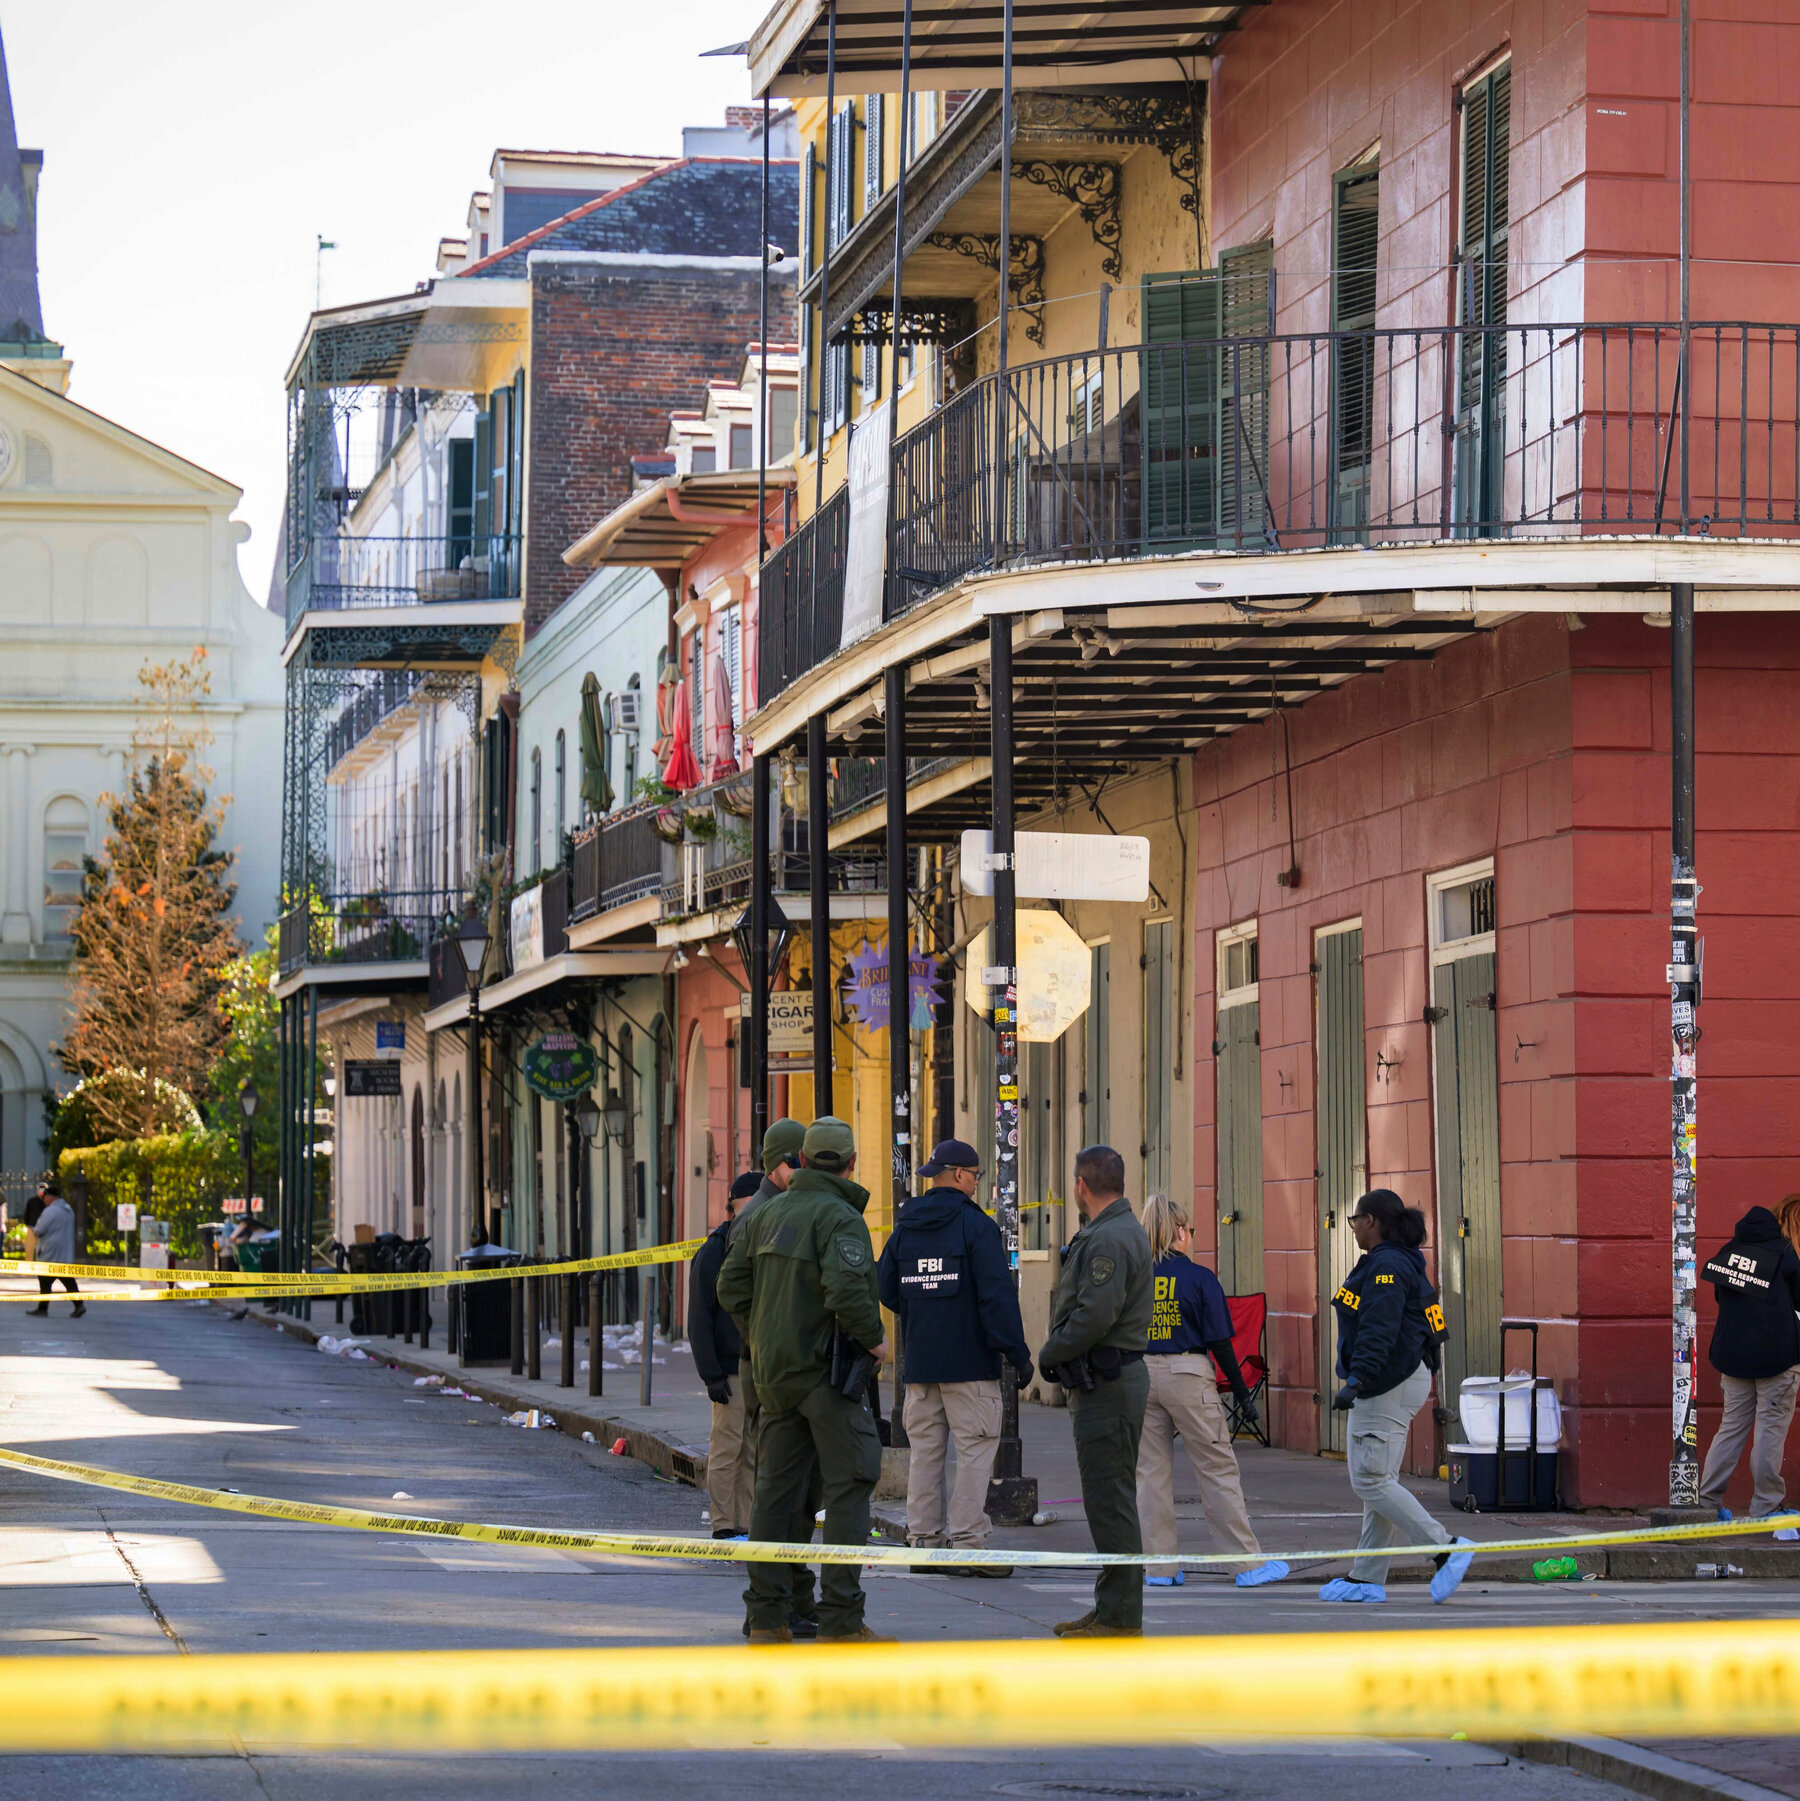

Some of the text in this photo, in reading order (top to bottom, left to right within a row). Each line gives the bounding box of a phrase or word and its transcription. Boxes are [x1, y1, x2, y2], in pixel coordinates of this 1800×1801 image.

[767, 1006, 814, 1019] IGAR
[771, 1020, 805, 1029] SHOP
[917, 1258, 943, 1273] FBI
[1727, 1253, 1757, 1274] FBI
[901, 1273, 959, 1284] EVIDENCE RESPONSE
[1375, 1274, 1394, 1284] FBI
[1706, 1262, 1770, 1289] EVIDENCE RESPONSE
[1728, 1276, 1746, 1288] TEAM
[922, 1282, 938, 1290] TEAM
[1154, 1276, 1176, 1301] BI
[1335, 1286, 1361, 1311] FBI
[1152, 1313, 1182, 1327] PONSE
[1424, 1304, 1447, 1334] FB
[1147, 1326, 1172, 1341] TEAM
